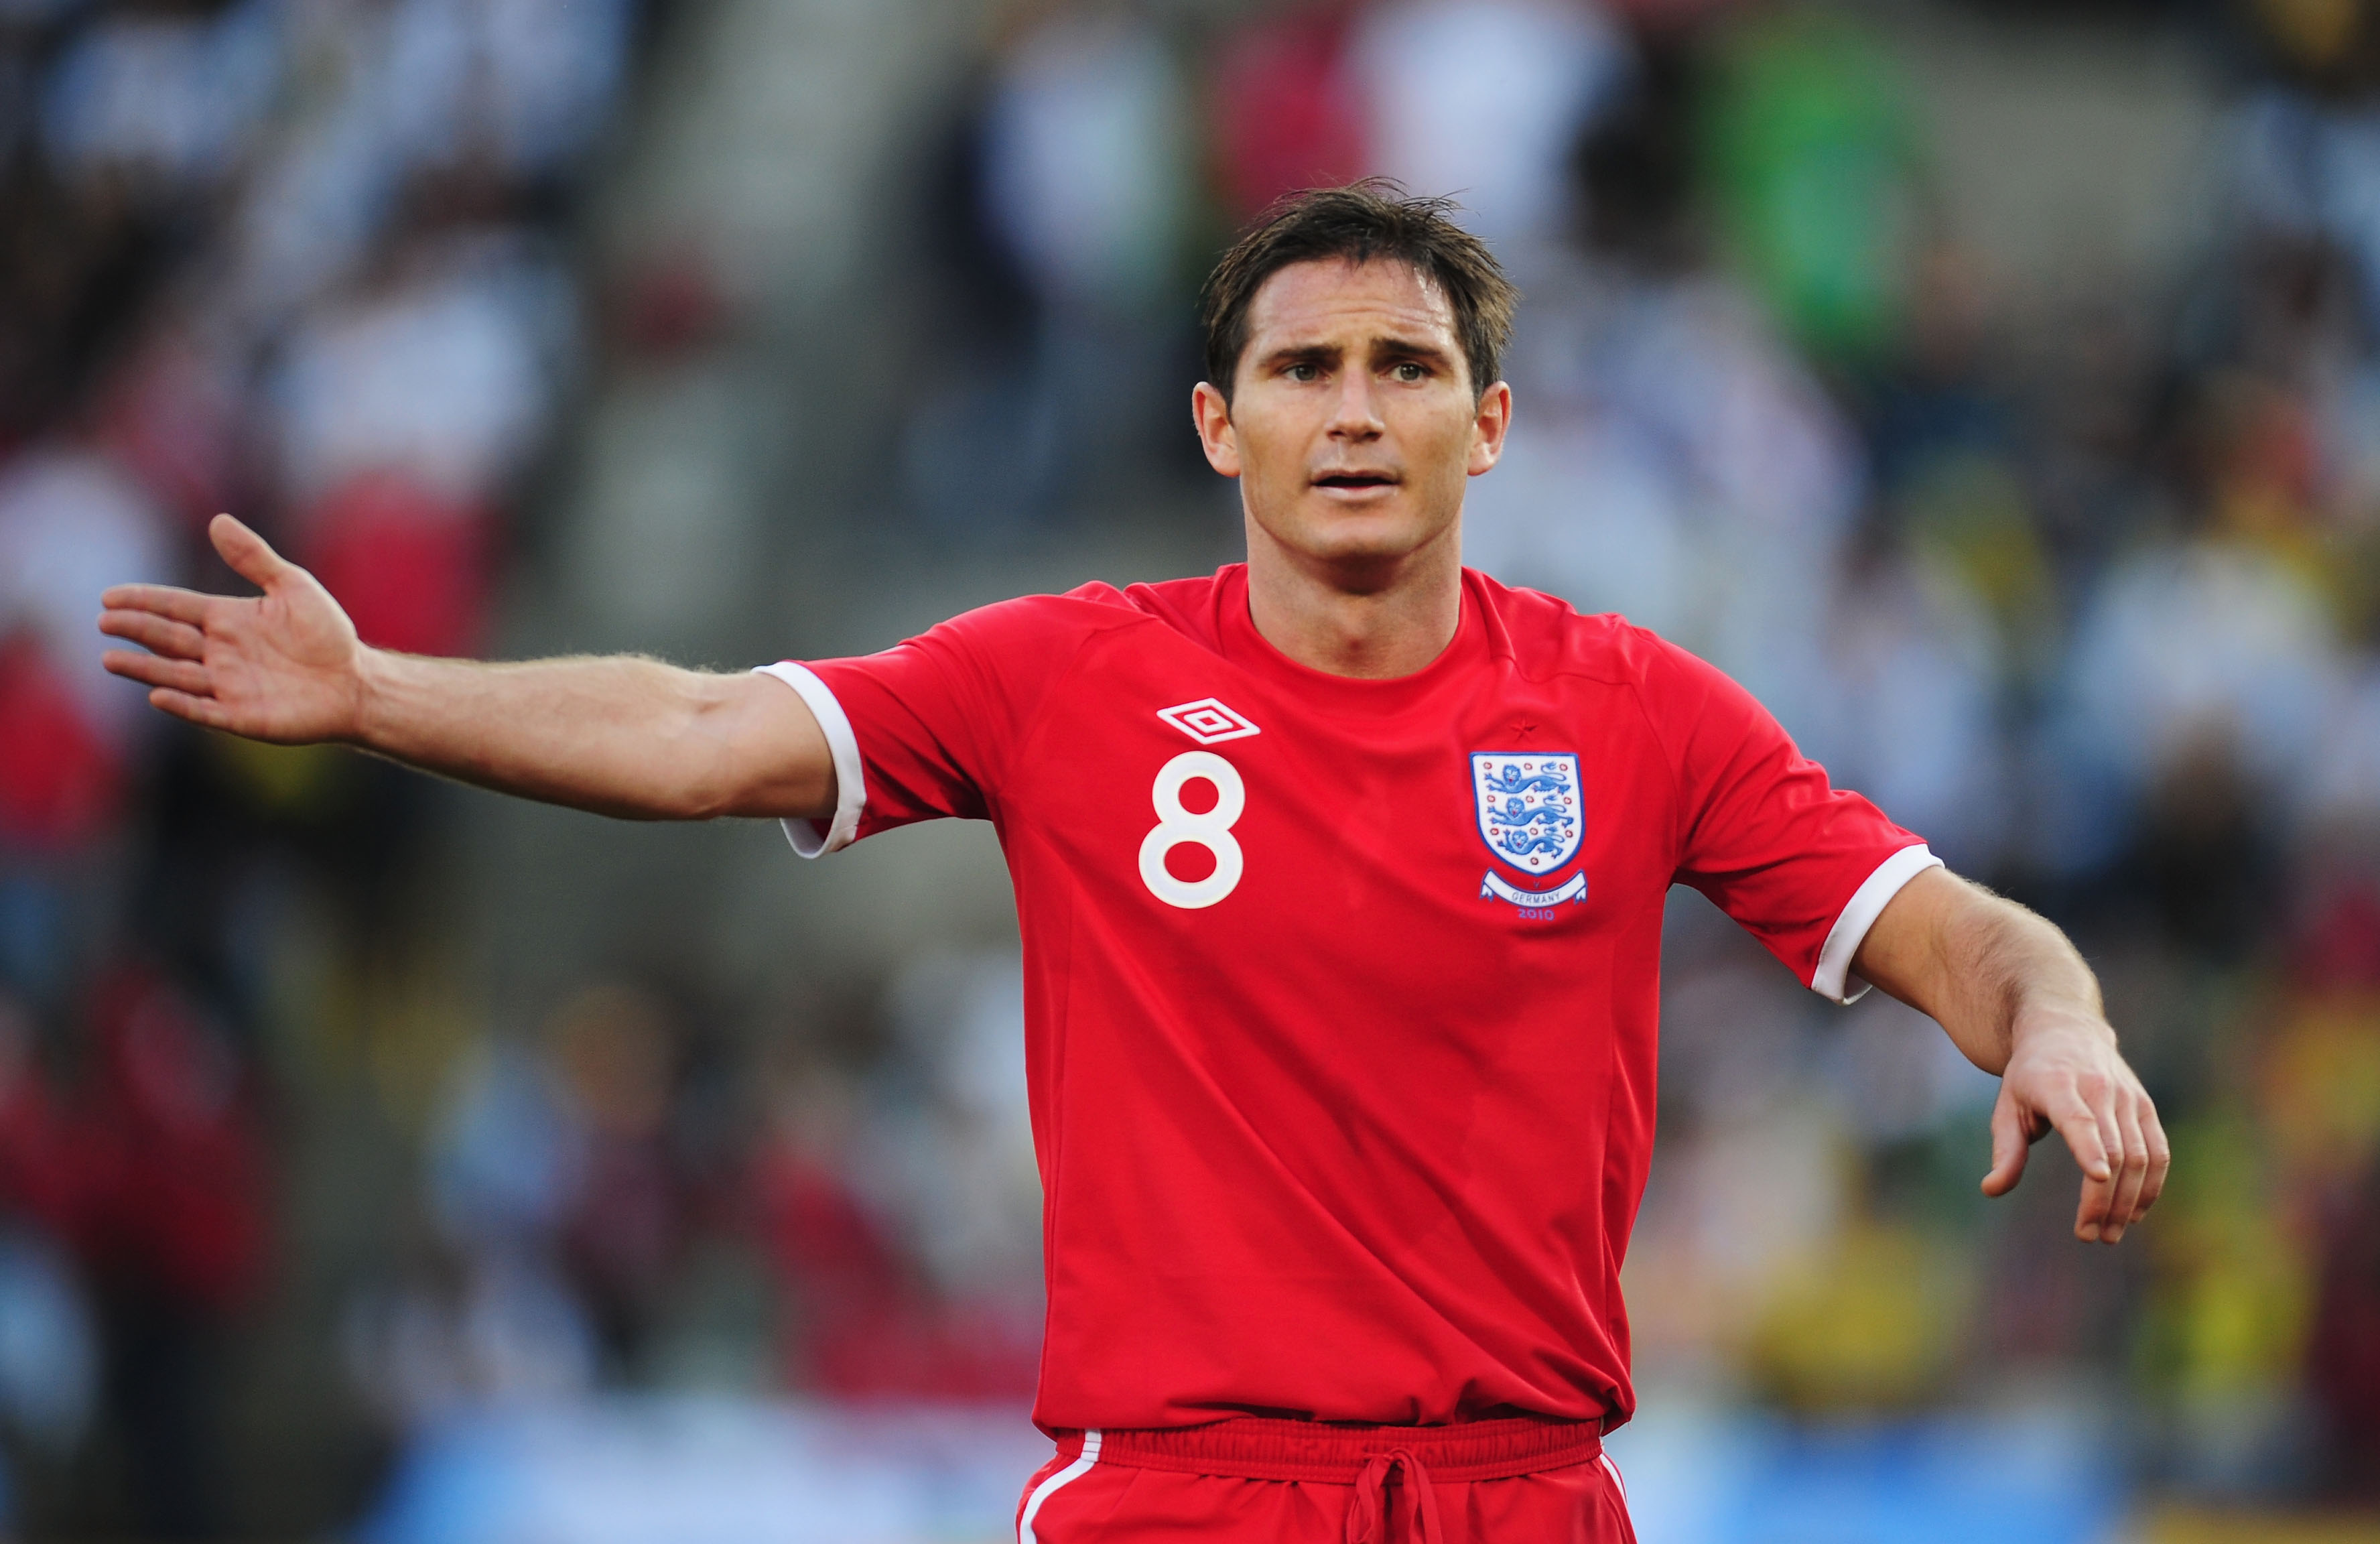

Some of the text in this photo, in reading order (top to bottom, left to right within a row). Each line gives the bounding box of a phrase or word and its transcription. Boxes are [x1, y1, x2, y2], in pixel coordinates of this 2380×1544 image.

[1138, 751, 1245, 909] 8
[1512, 892, 1560, 903] GERMANY
[1518, 909, 1555, 921] 2010
